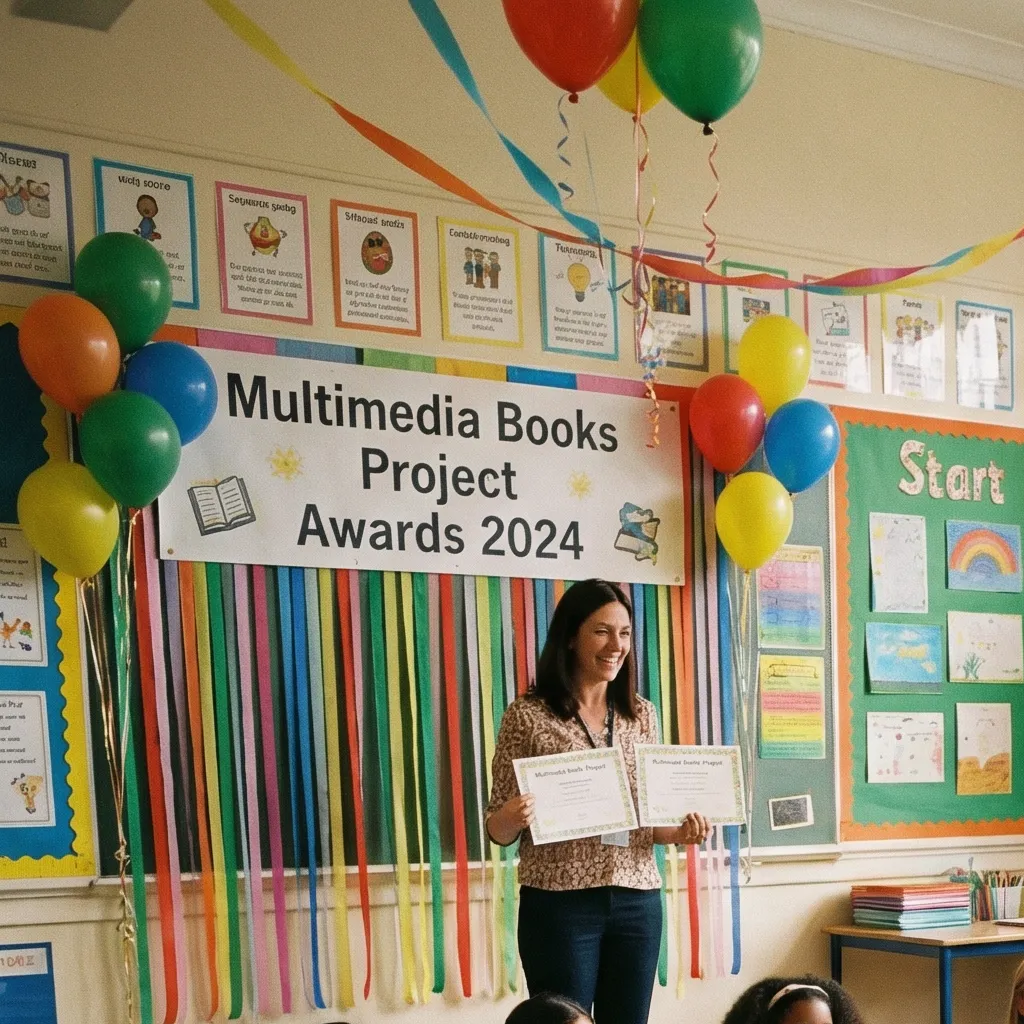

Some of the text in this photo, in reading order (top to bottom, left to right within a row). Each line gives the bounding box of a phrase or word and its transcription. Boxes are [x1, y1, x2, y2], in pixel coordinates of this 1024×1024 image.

[227, 372, 619, 453] Multimedia Books
[361, 446, 518, 506] Project
[898, 439, 1005, 505] Start
[297, 503, 585, 560] Awards 2024
